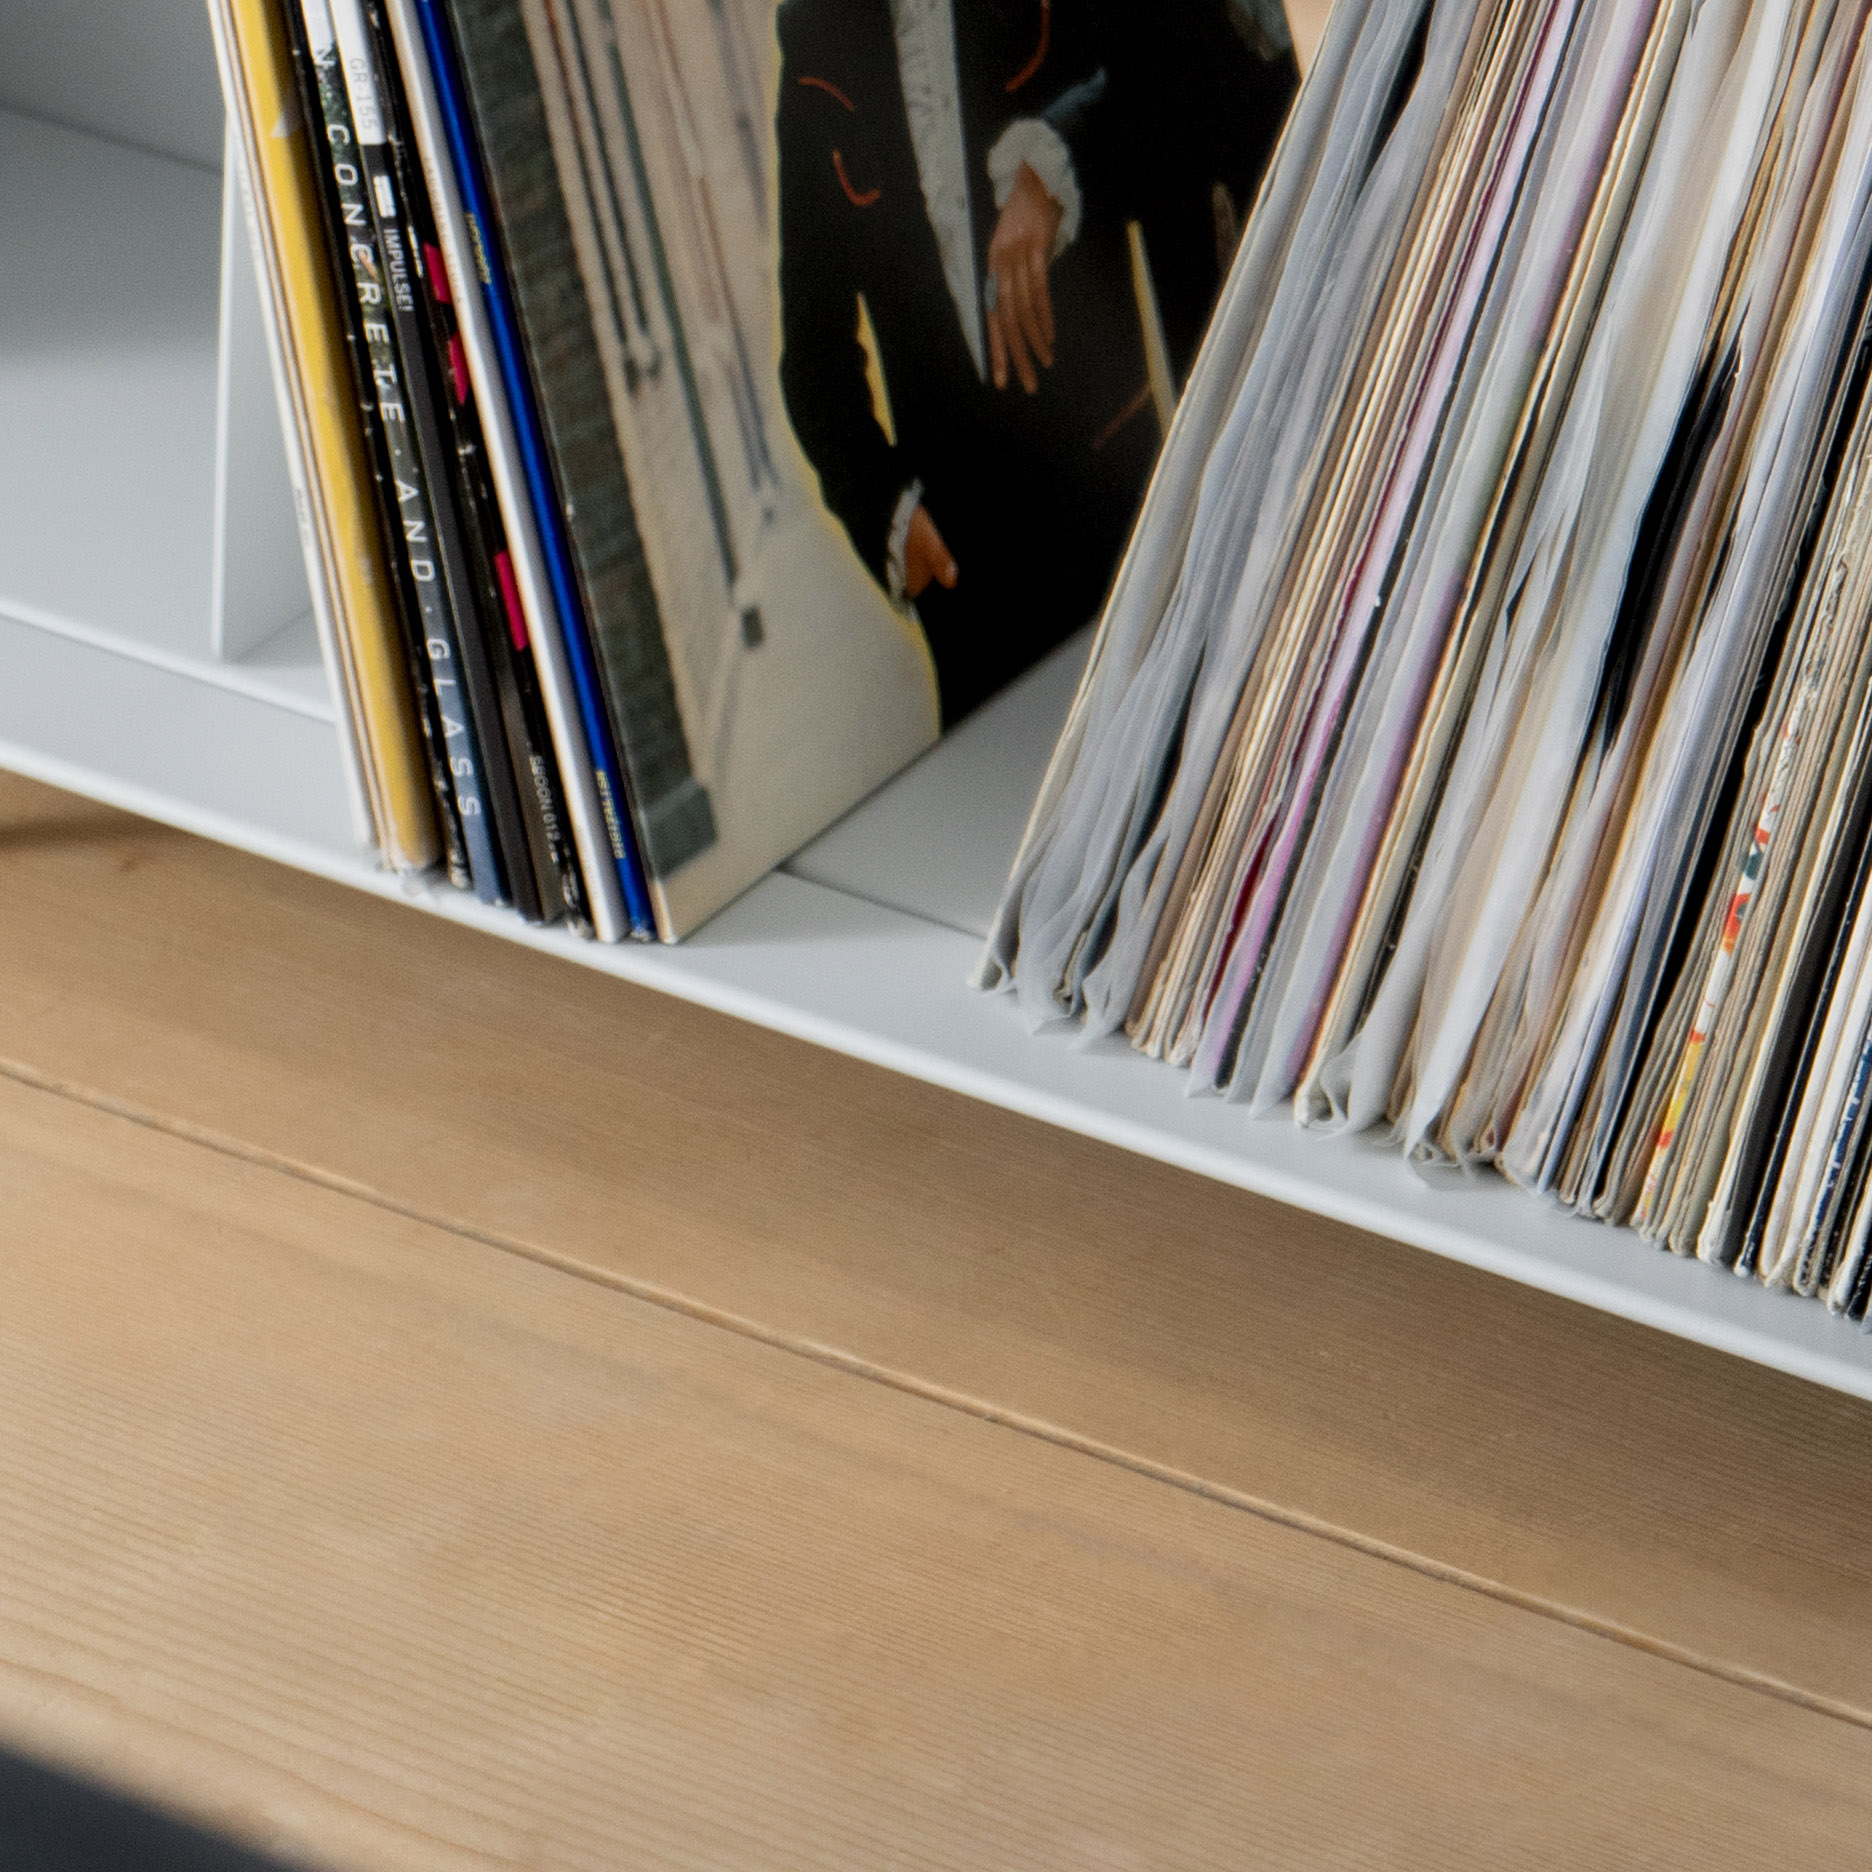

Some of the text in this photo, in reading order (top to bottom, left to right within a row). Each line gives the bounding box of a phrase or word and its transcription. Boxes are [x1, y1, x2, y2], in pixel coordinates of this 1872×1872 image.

[383, 227, 414, 312] IMPULSE!
[328, 123, 405, 424] CONCRETE
[396, 479, 436, 584] AND
[427, 637, 482, 818] GLASS
